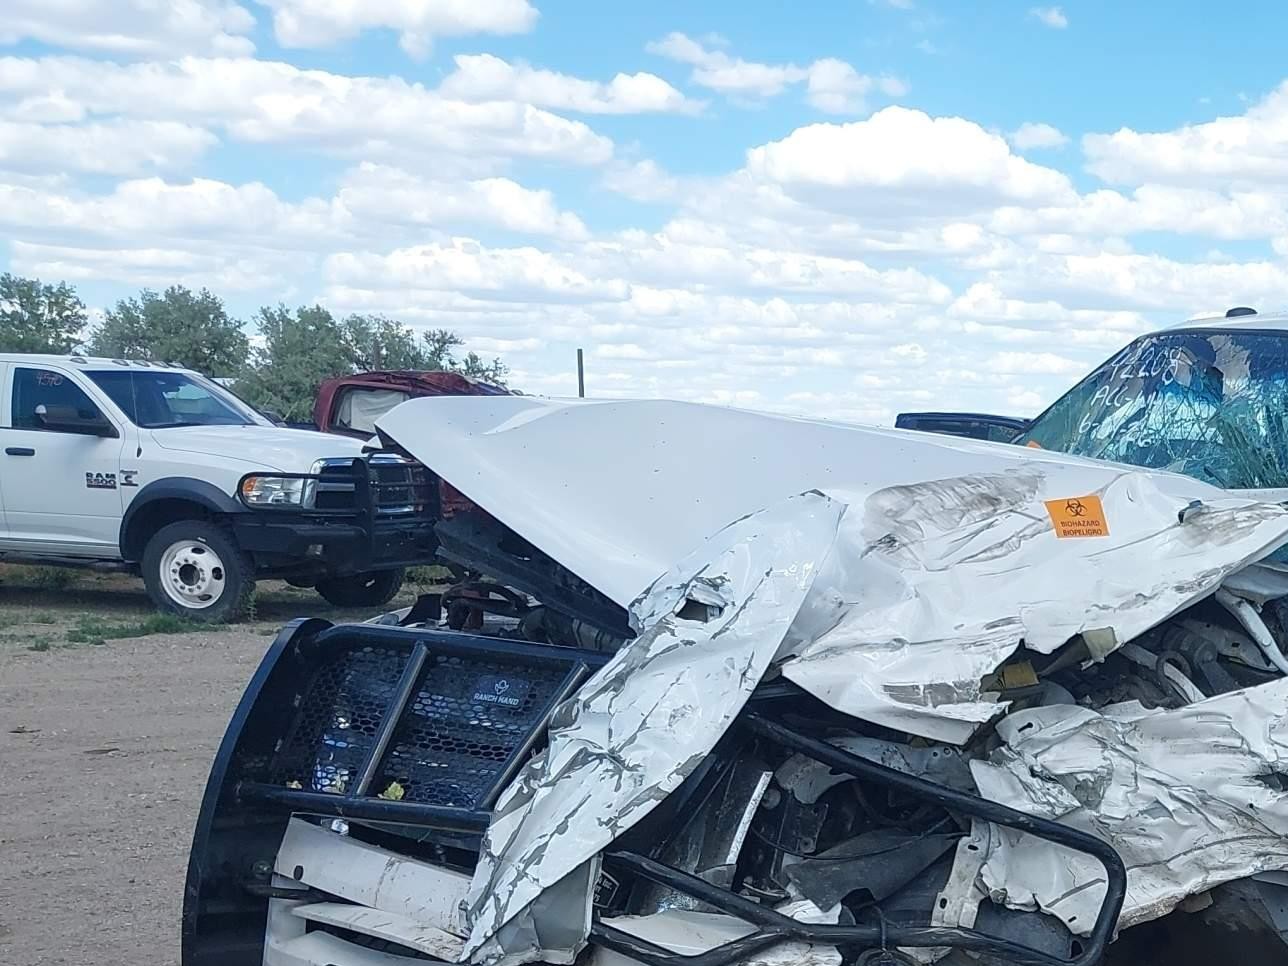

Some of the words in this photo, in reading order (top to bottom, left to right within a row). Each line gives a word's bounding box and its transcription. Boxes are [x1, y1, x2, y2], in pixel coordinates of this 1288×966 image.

[86, 472, 116, 480] RAM
[1063, 528, 1102, 536] BIOPELIGRO
[473, 693, 497, 702] RANCH
[498, 696, 519, 705] HAND
